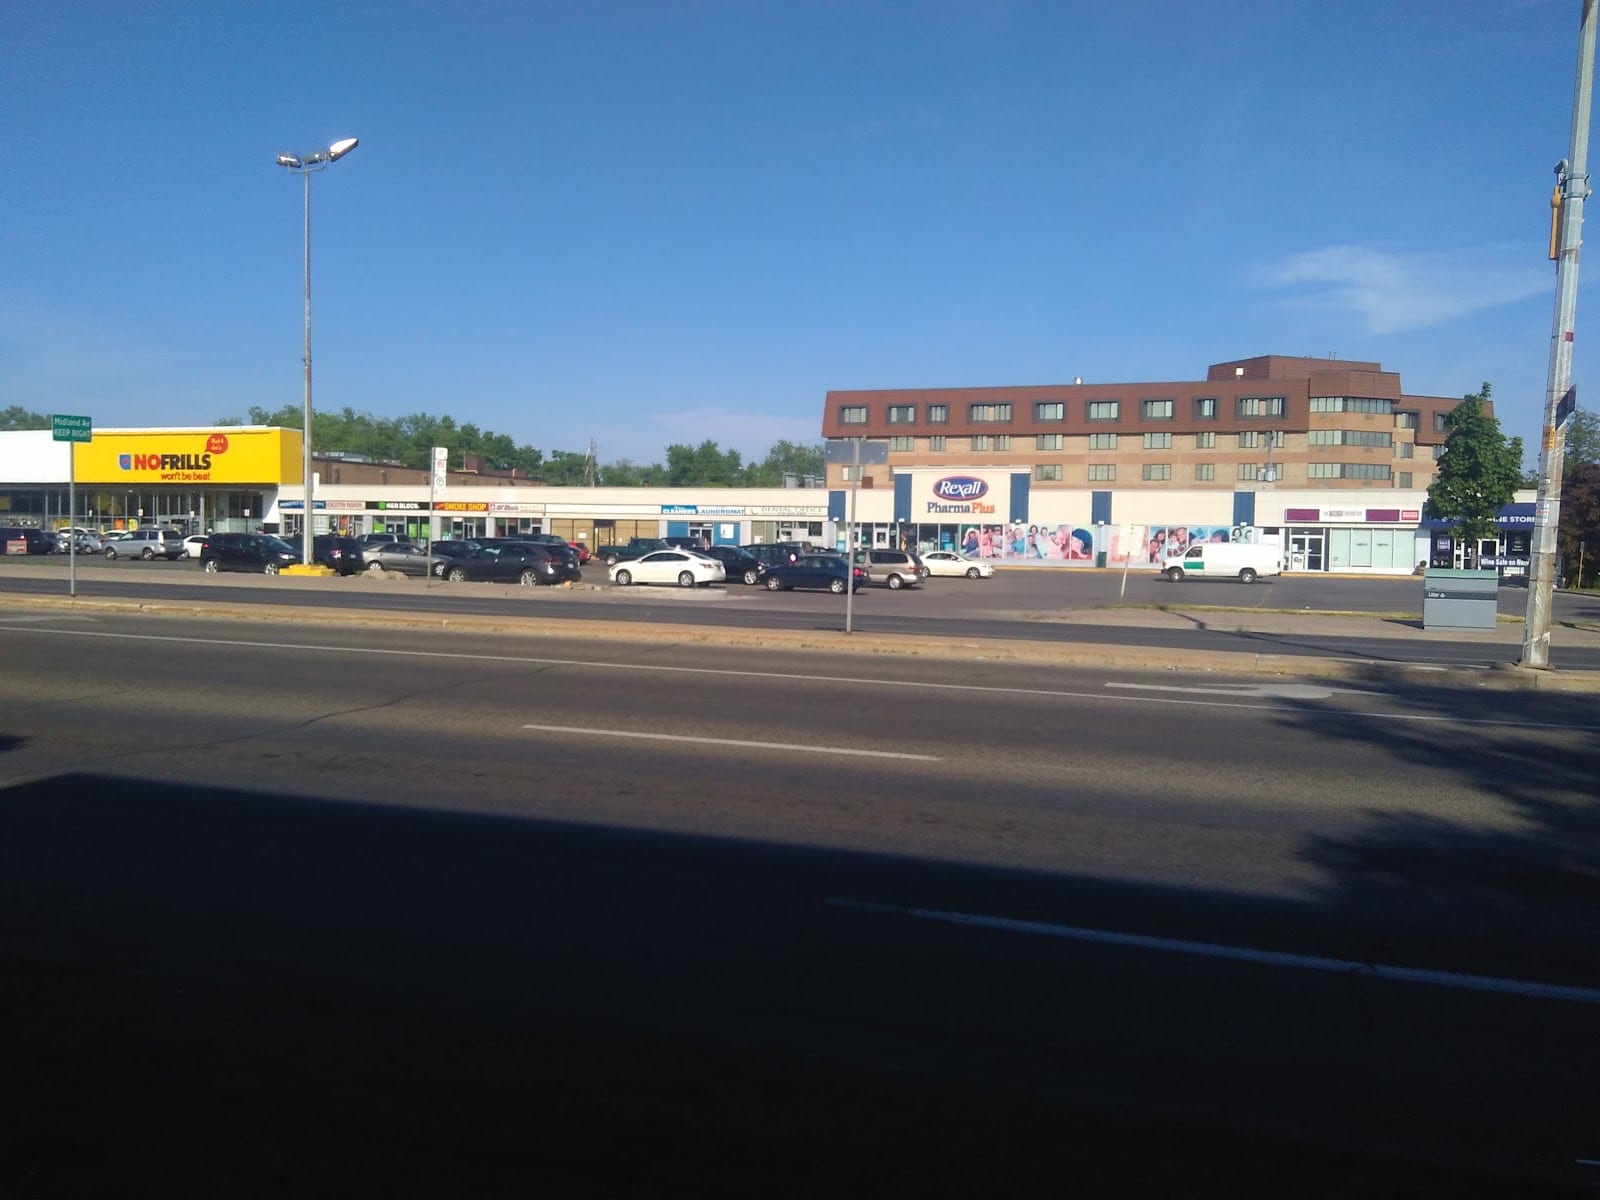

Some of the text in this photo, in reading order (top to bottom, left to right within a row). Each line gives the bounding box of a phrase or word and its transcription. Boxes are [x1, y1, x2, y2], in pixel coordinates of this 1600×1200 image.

[54, 417, 81, 427] Midland
[53, 428, 91, 438] KEEP RIGHT
[161, 472, 211, 480] won't be beat
[940, 481, 981, 498] Rexall
[443, 502, 467, 511] SMOKE
[467, 502, 487, 511] SHOP
[927, 501, 995, 514] Pharma Plus
[1480, 558, 1495, 566] Wine
[1495, 558, 1508, 566] Sale
